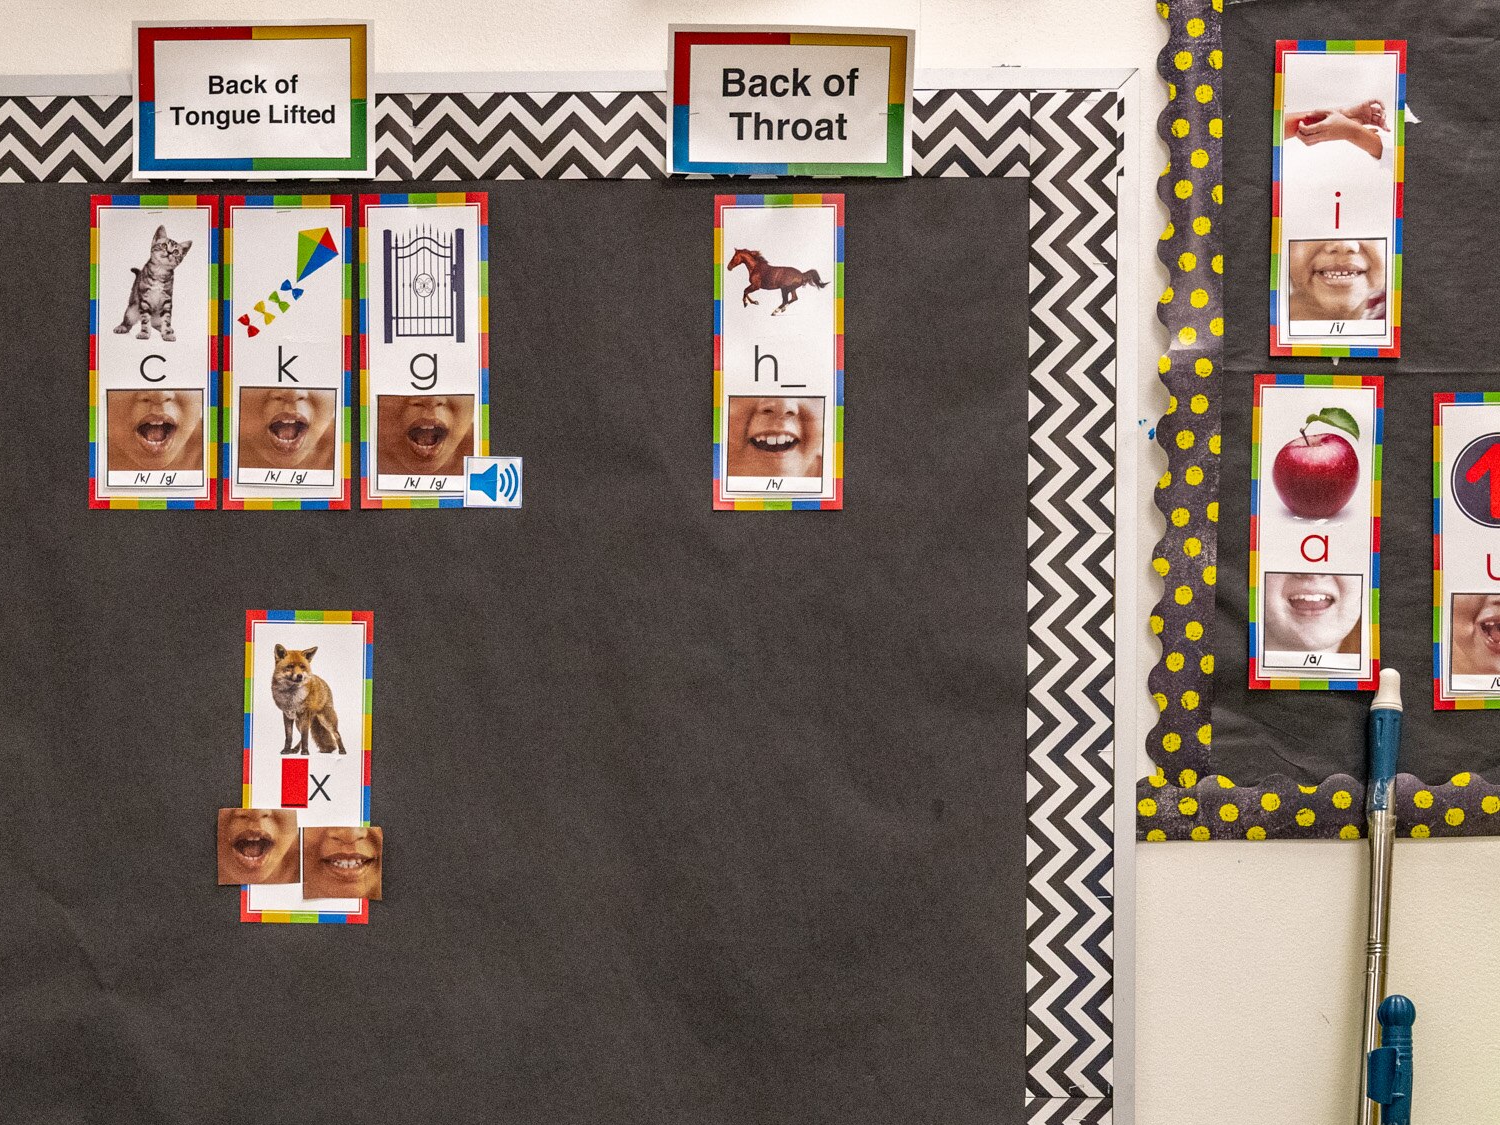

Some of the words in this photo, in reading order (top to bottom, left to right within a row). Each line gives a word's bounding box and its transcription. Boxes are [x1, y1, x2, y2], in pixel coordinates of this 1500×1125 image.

[209, 75, 267, 94] Back
[275, 74, 298, 94] of
[723, 68, 811, 97] Back
[824, 68, 859, 96] of
[170, 107, 260, 130] Tongue
[269, 105, 335, 124] Lifted
[729, 112, 847, 140] Throat
[1335, 192, 1341, 229] i
[140, 355, 166, 382] c
[278, 346, 299, 382] k
[410, 353, 437, 390] g
[135, 473, 150, 484] /k/
[160, 473, 178, 487] /g/
[265, 471, 281, 482] /k/
[290, 471, 308, 485] /g/
[404, 477, 420, 488] /k/
[429, 478, 448, 492] /g/
[766, 479, 783, 490] /h/
[1301, 535, 1328, 562] a
